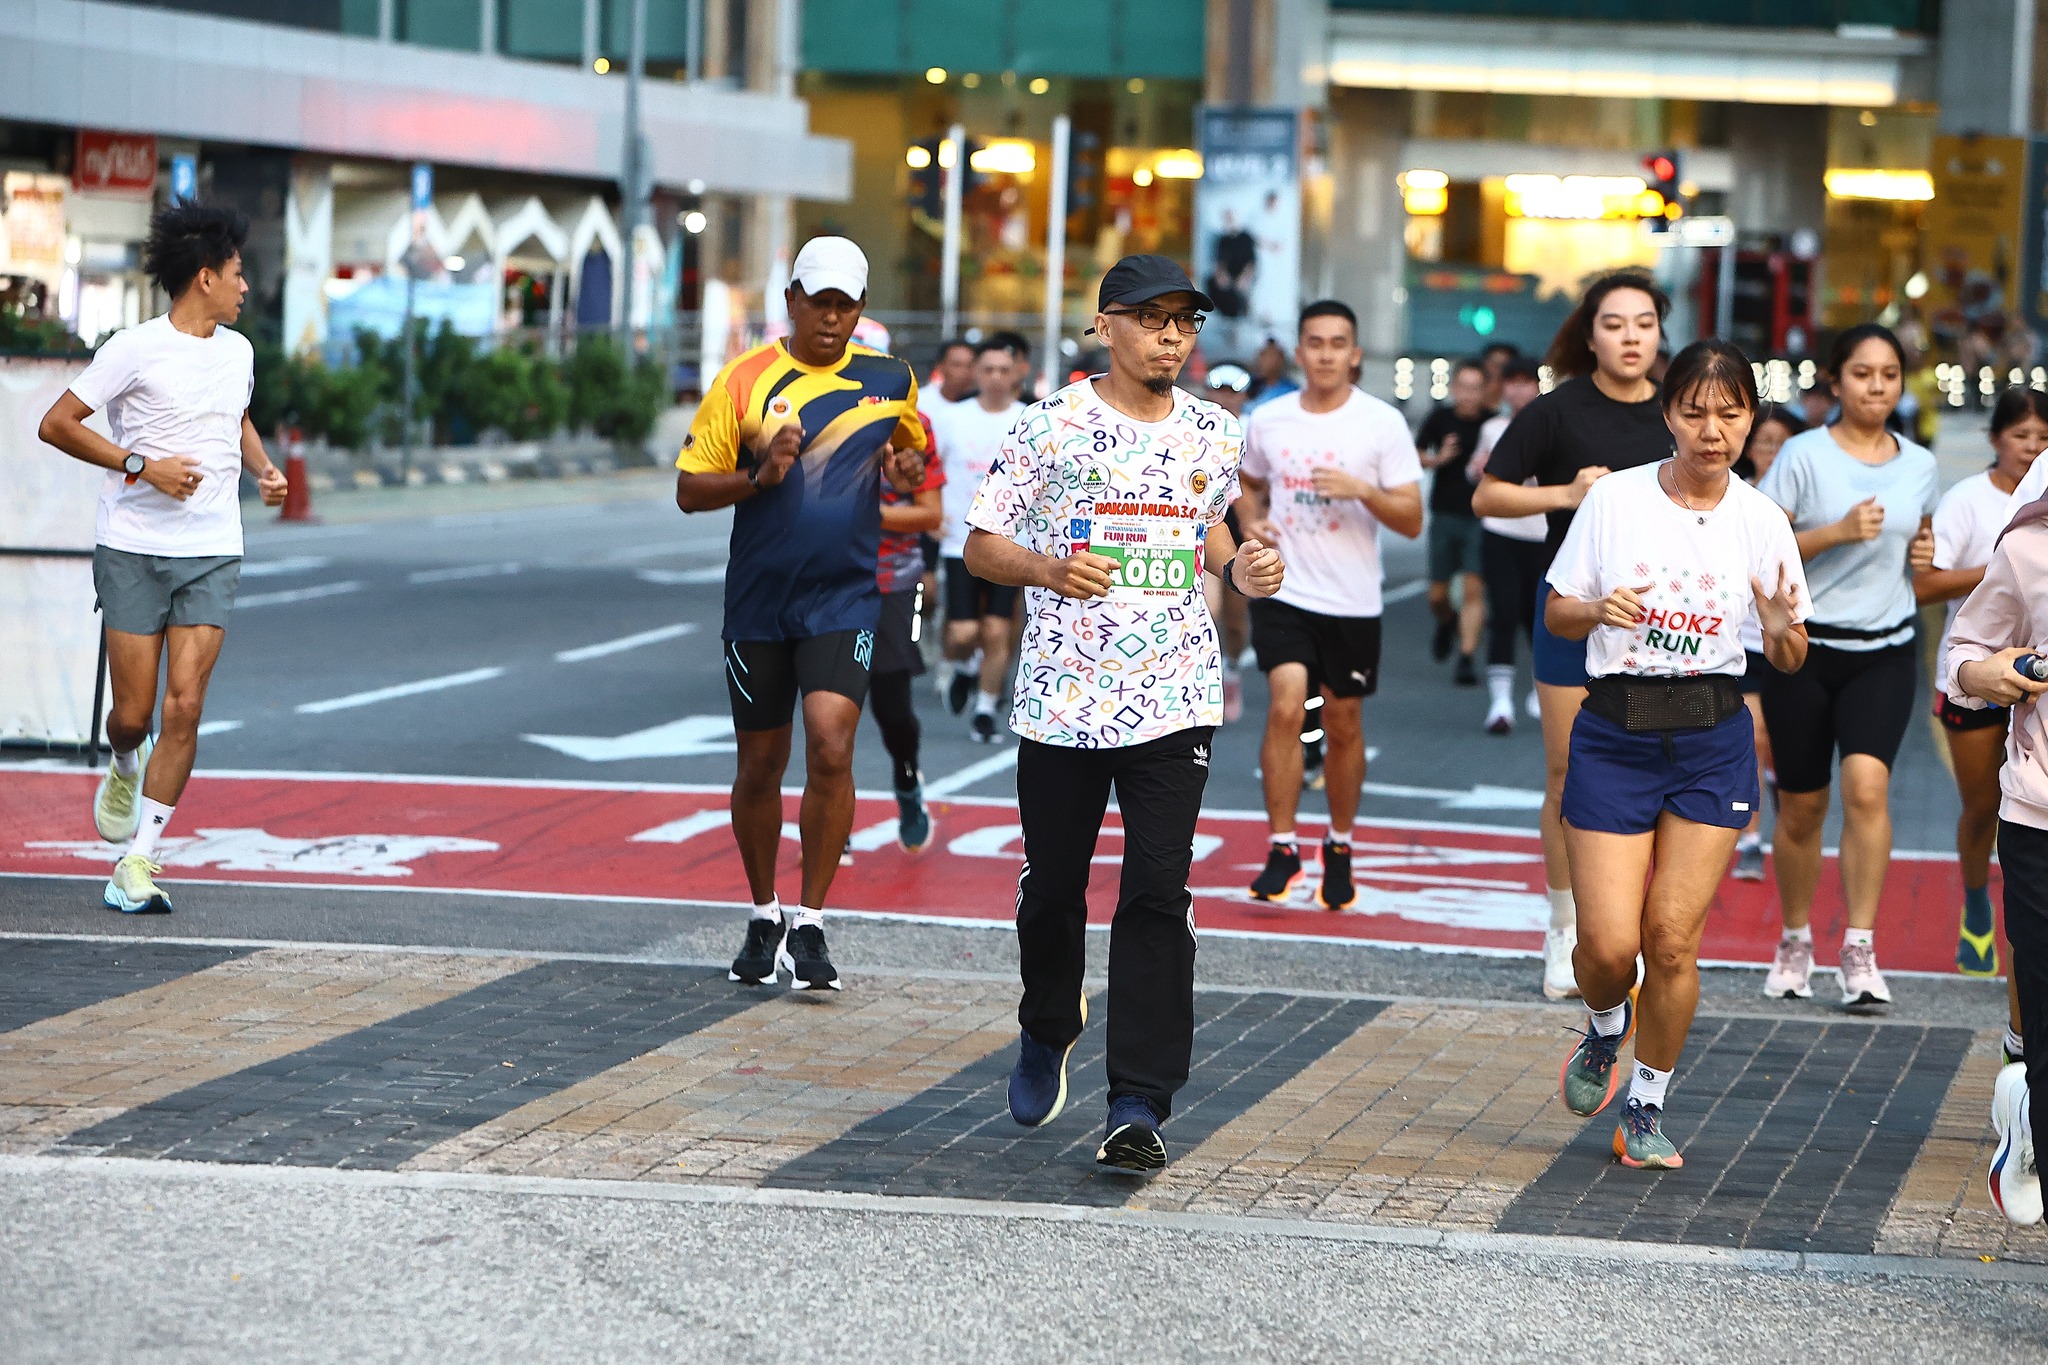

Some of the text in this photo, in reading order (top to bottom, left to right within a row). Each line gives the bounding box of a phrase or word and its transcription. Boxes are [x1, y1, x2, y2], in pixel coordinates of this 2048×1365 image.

[1094, 502, 1139, 516] RAKAN
[1140, 504, 1180, 518] MUDA
[1103, 532, 1147, 543] FUN RUN
[1123, 548, 1173, 560] FUN RUN
[1633, 604, 1723, 636] SHOKZ
[1645, 628, 1702, 656] RUN
